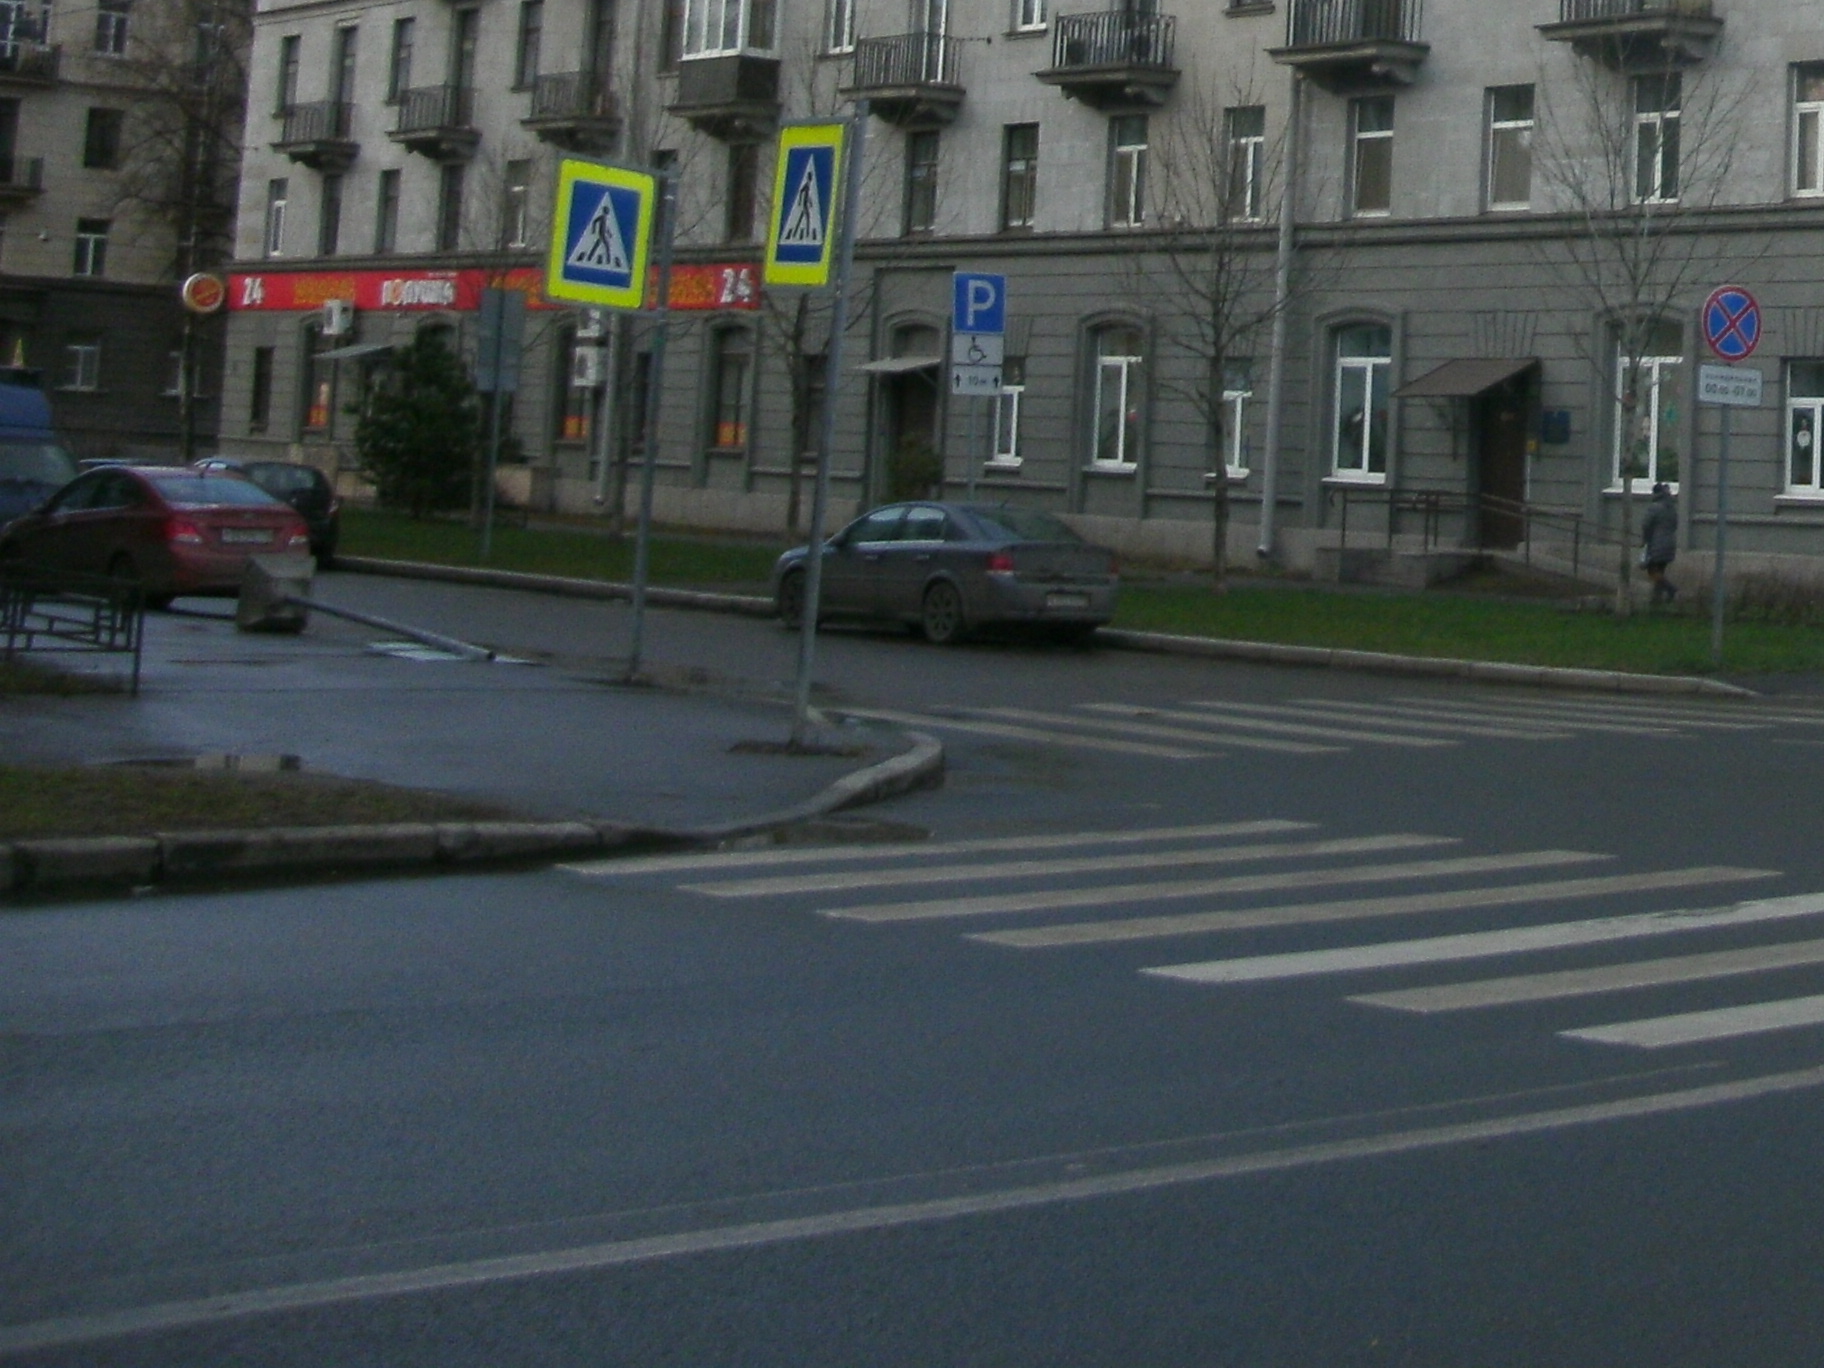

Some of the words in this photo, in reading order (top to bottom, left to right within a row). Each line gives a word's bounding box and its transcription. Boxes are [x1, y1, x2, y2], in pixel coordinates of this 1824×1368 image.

[242, 277, 264, 305] 24
[720, 268, 751, 303] 24
[968, 279, 996, 326] P
